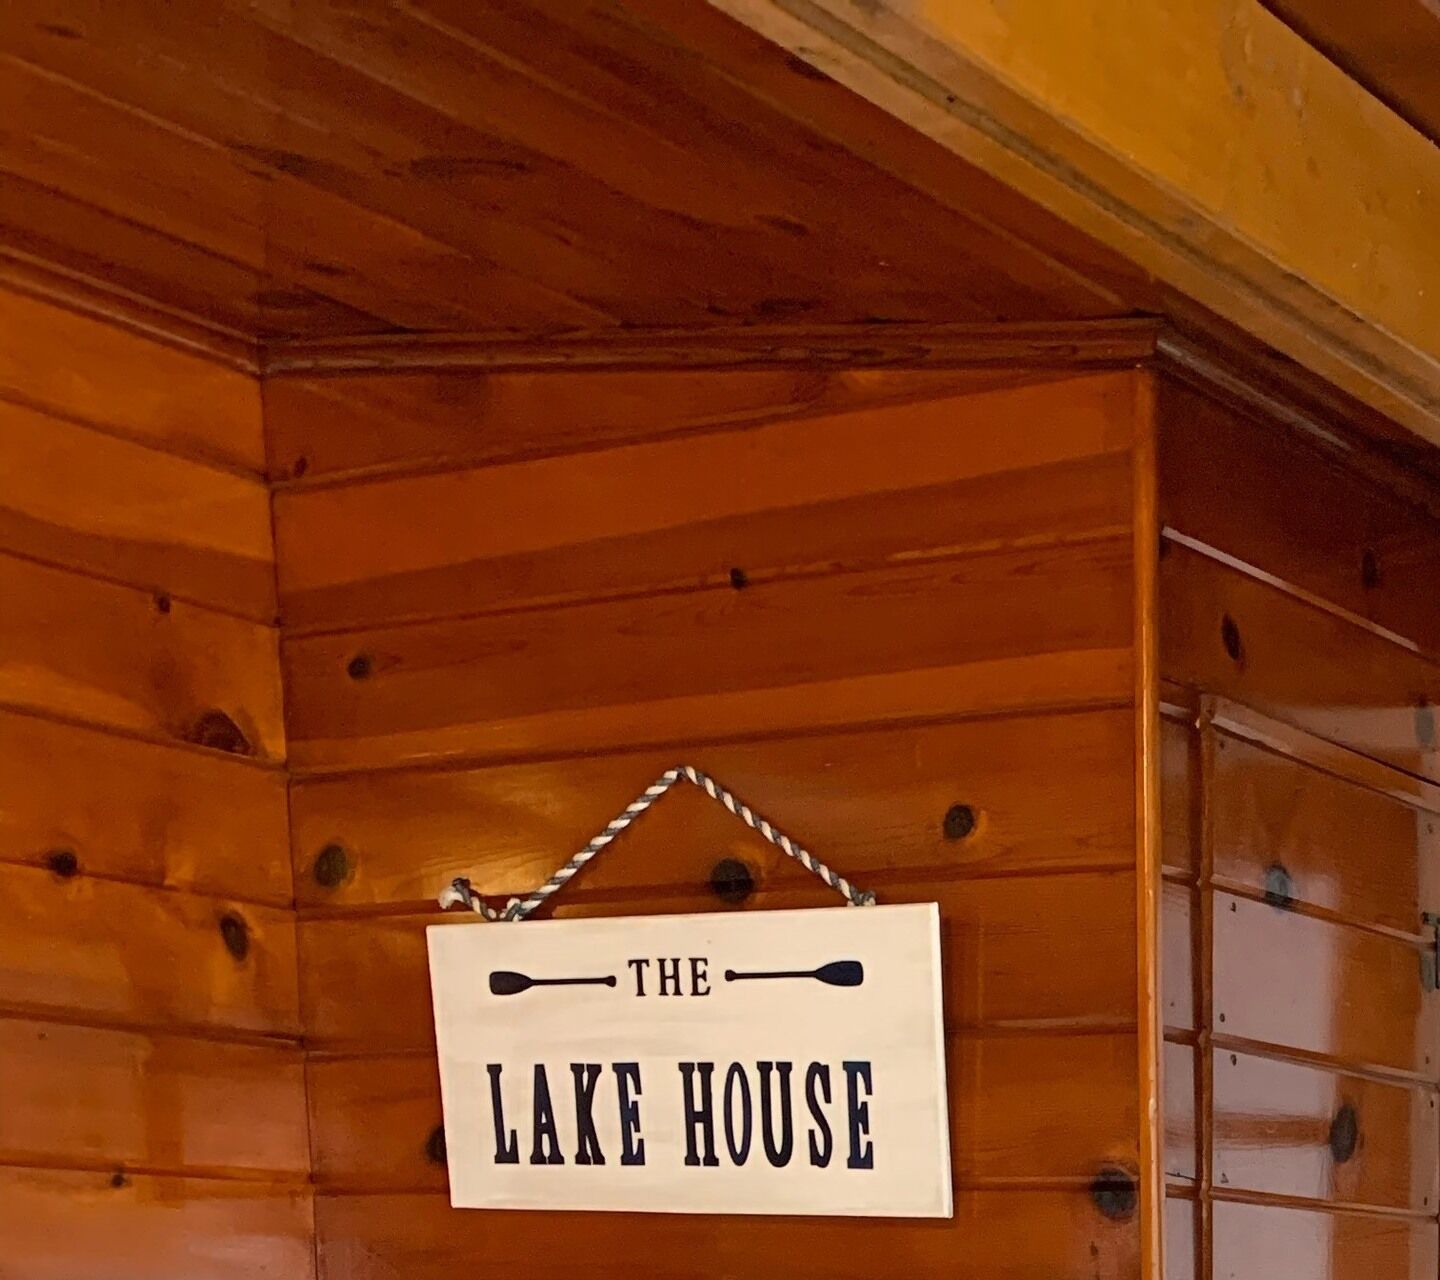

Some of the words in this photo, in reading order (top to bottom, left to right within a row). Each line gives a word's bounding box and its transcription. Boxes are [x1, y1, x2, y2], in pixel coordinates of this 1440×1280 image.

[628, 957, 712, 997] THE
[487, 1062, 646, 1166] LAKE
[678, 1060, 875, 1169] HOUSE
